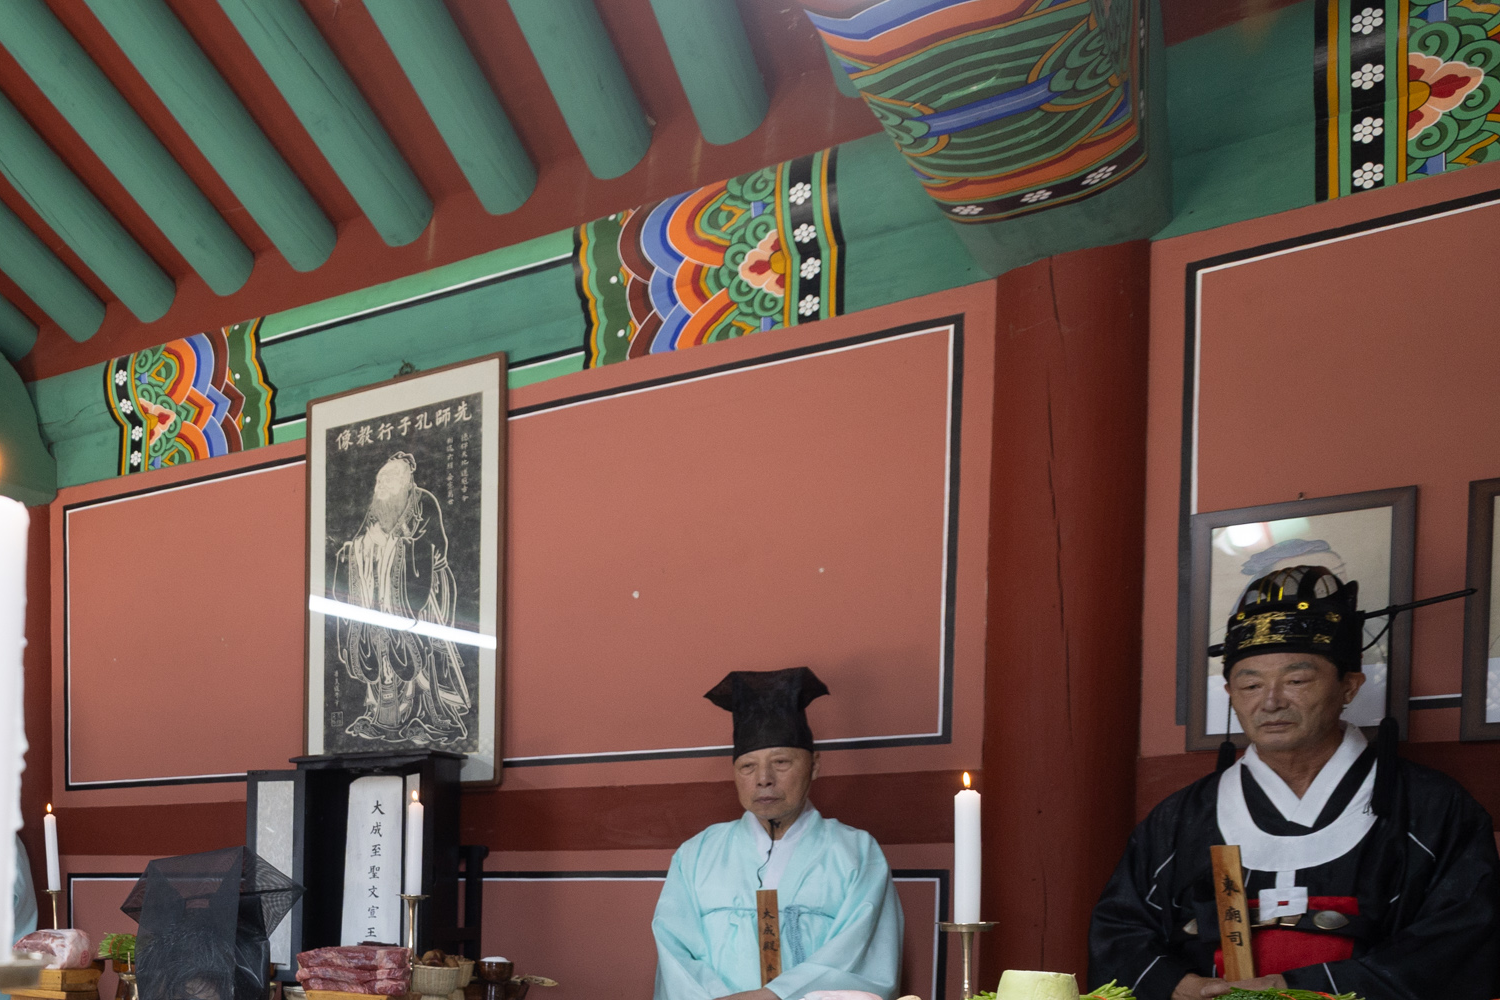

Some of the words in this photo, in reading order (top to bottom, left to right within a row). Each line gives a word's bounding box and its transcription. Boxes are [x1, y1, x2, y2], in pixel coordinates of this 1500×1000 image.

[365, 800, 386, 939] 大成至聖文宣王
